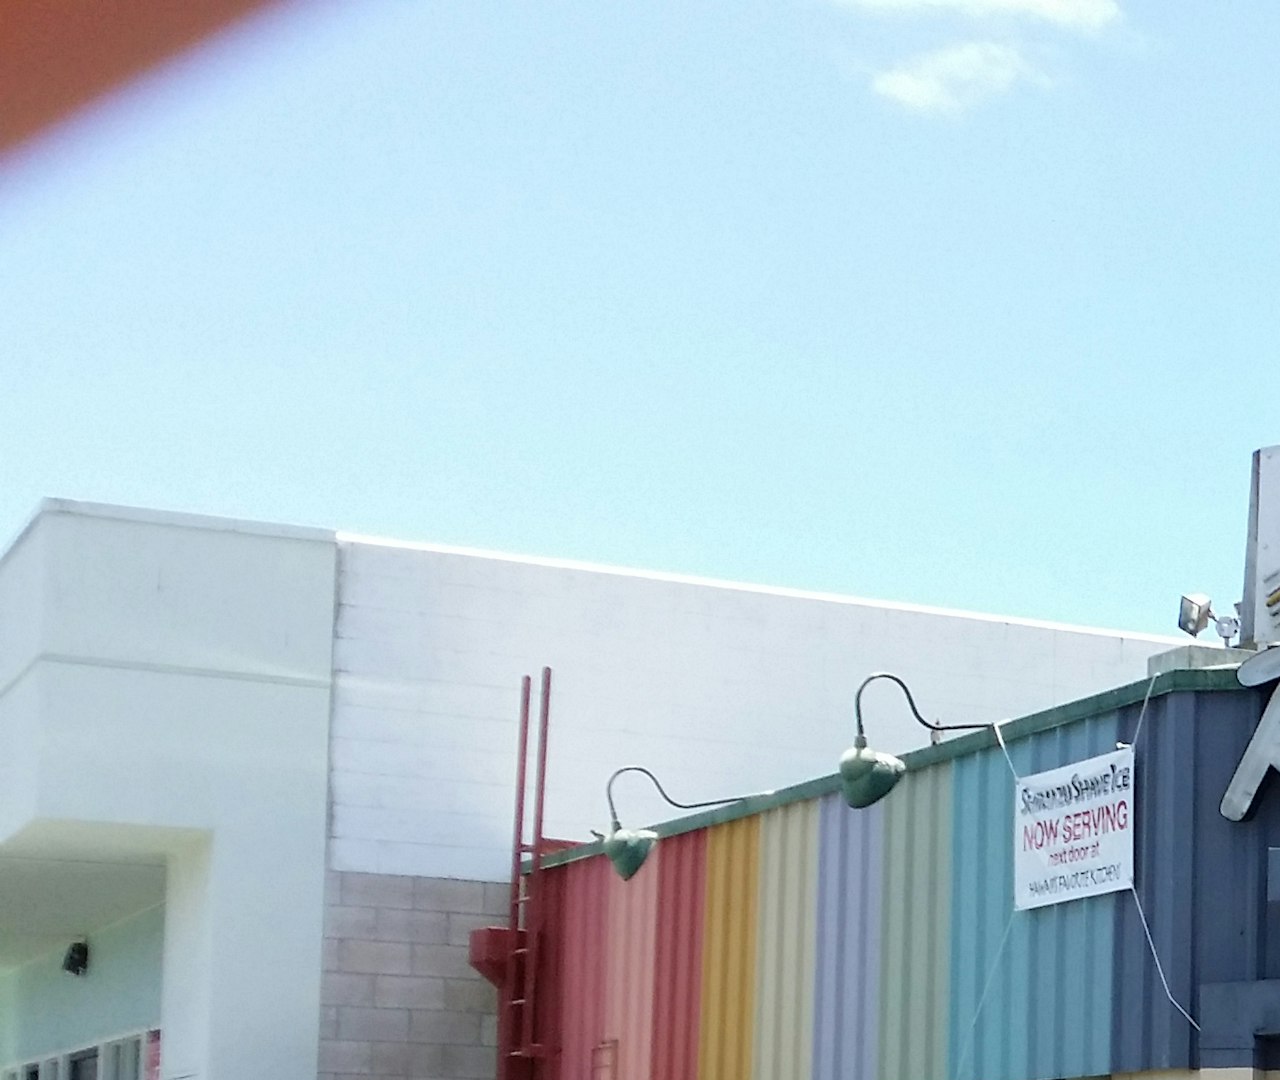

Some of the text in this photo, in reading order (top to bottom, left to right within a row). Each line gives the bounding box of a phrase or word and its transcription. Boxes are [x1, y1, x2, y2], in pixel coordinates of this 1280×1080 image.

[1023, 800, 1128, 851] NOW SERVING
[1068, 845, 1089, 863] door
